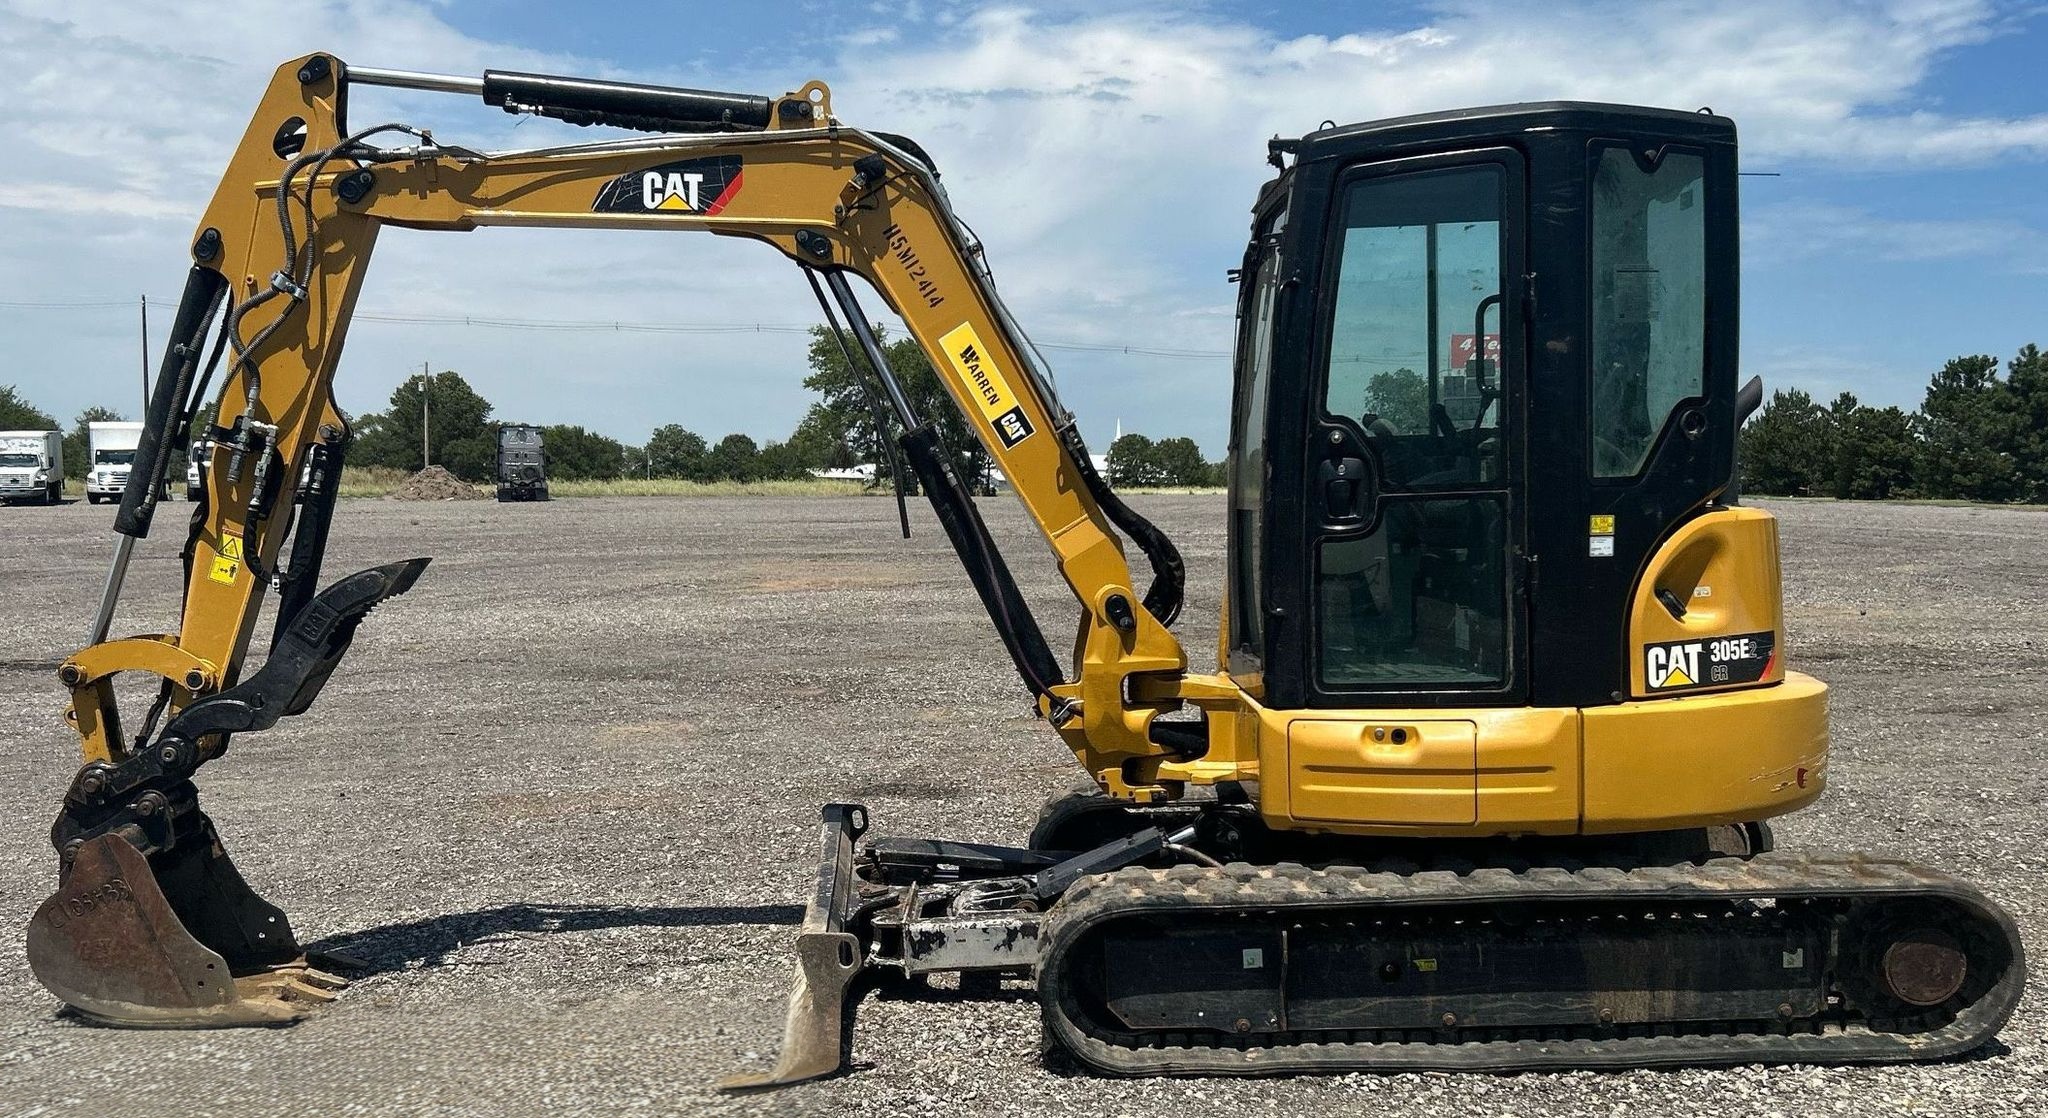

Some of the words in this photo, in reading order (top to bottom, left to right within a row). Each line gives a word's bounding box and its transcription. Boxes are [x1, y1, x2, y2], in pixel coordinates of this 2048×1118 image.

[643, 171, 703, 211] CAT
[883, 223, 945, 308] H5M12414
[959, 343, 1000, 406] WARREN
[1000, 412, 1027, 441] CAT
[1647, 643, 1703, 688] CAT
[1710, 638, 1758, 662] 305E2
[1710, 665, 1729, 682] CR
